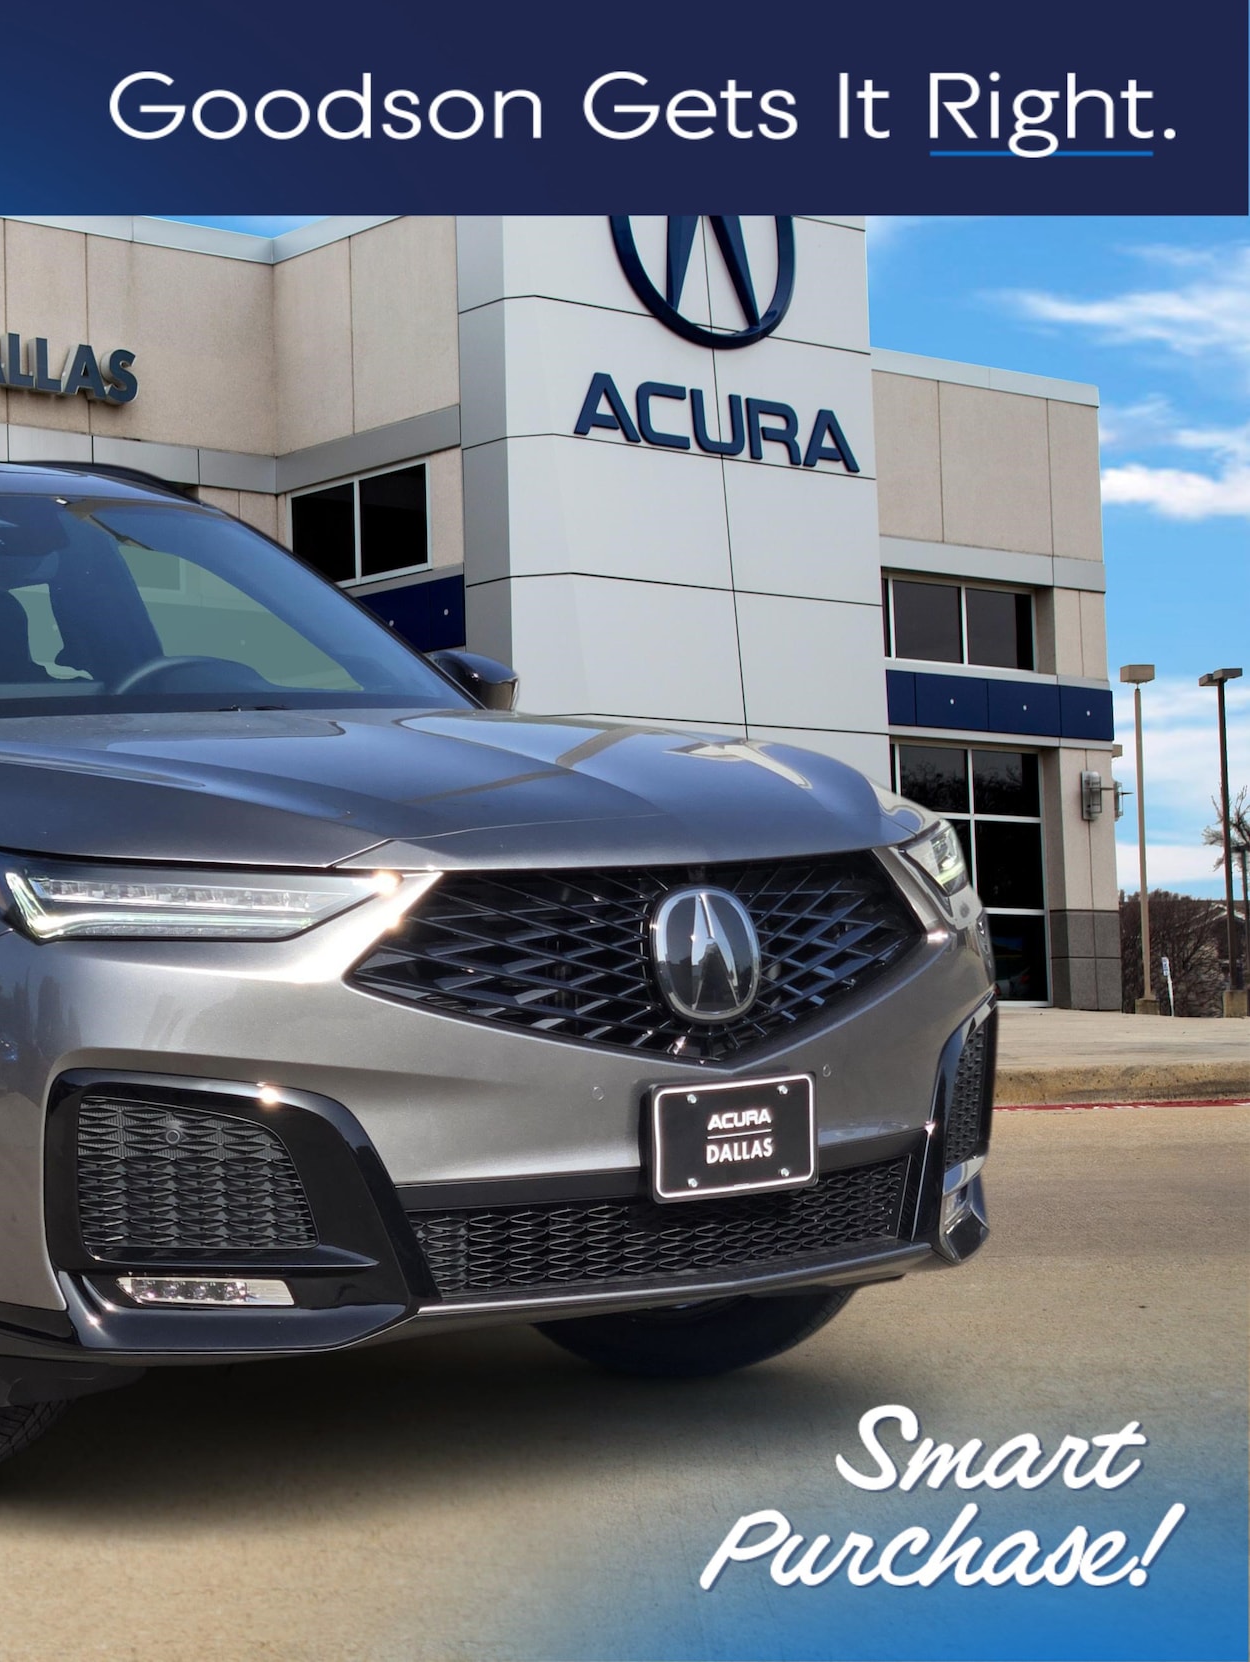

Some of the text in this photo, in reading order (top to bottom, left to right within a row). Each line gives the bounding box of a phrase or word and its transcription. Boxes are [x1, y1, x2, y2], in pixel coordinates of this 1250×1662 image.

[573, 371, 861, 474] ACURA
[707, 1108, 772, 1131] ACURA
[706, 1137, 774, 1165] DALLAS
